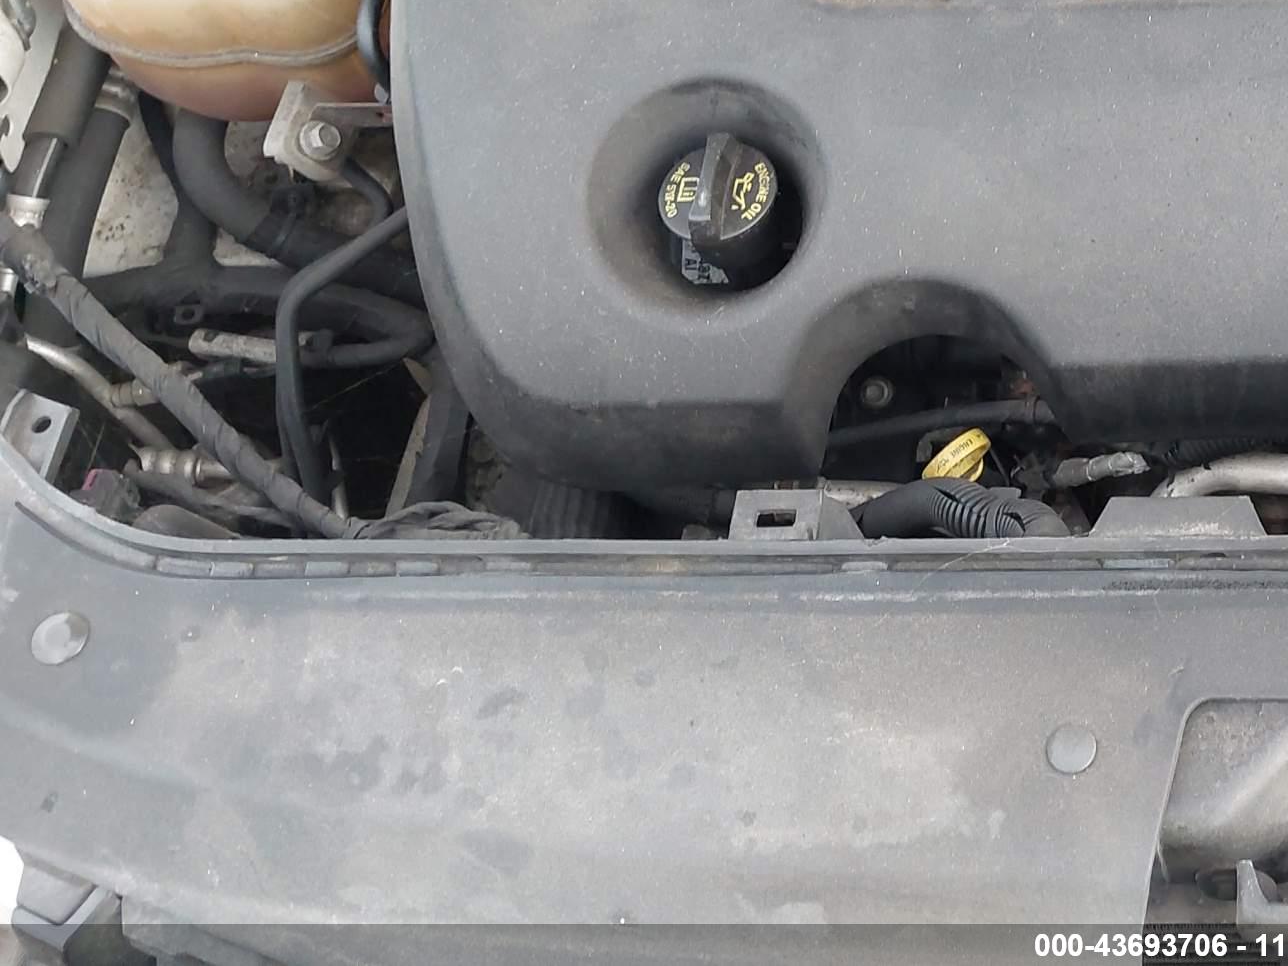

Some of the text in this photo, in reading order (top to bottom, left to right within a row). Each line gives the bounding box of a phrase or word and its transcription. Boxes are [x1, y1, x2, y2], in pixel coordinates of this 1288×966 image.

[669, 162, 690, 184] SAE
[741, 162, 770, 221] ENGINE OIL
